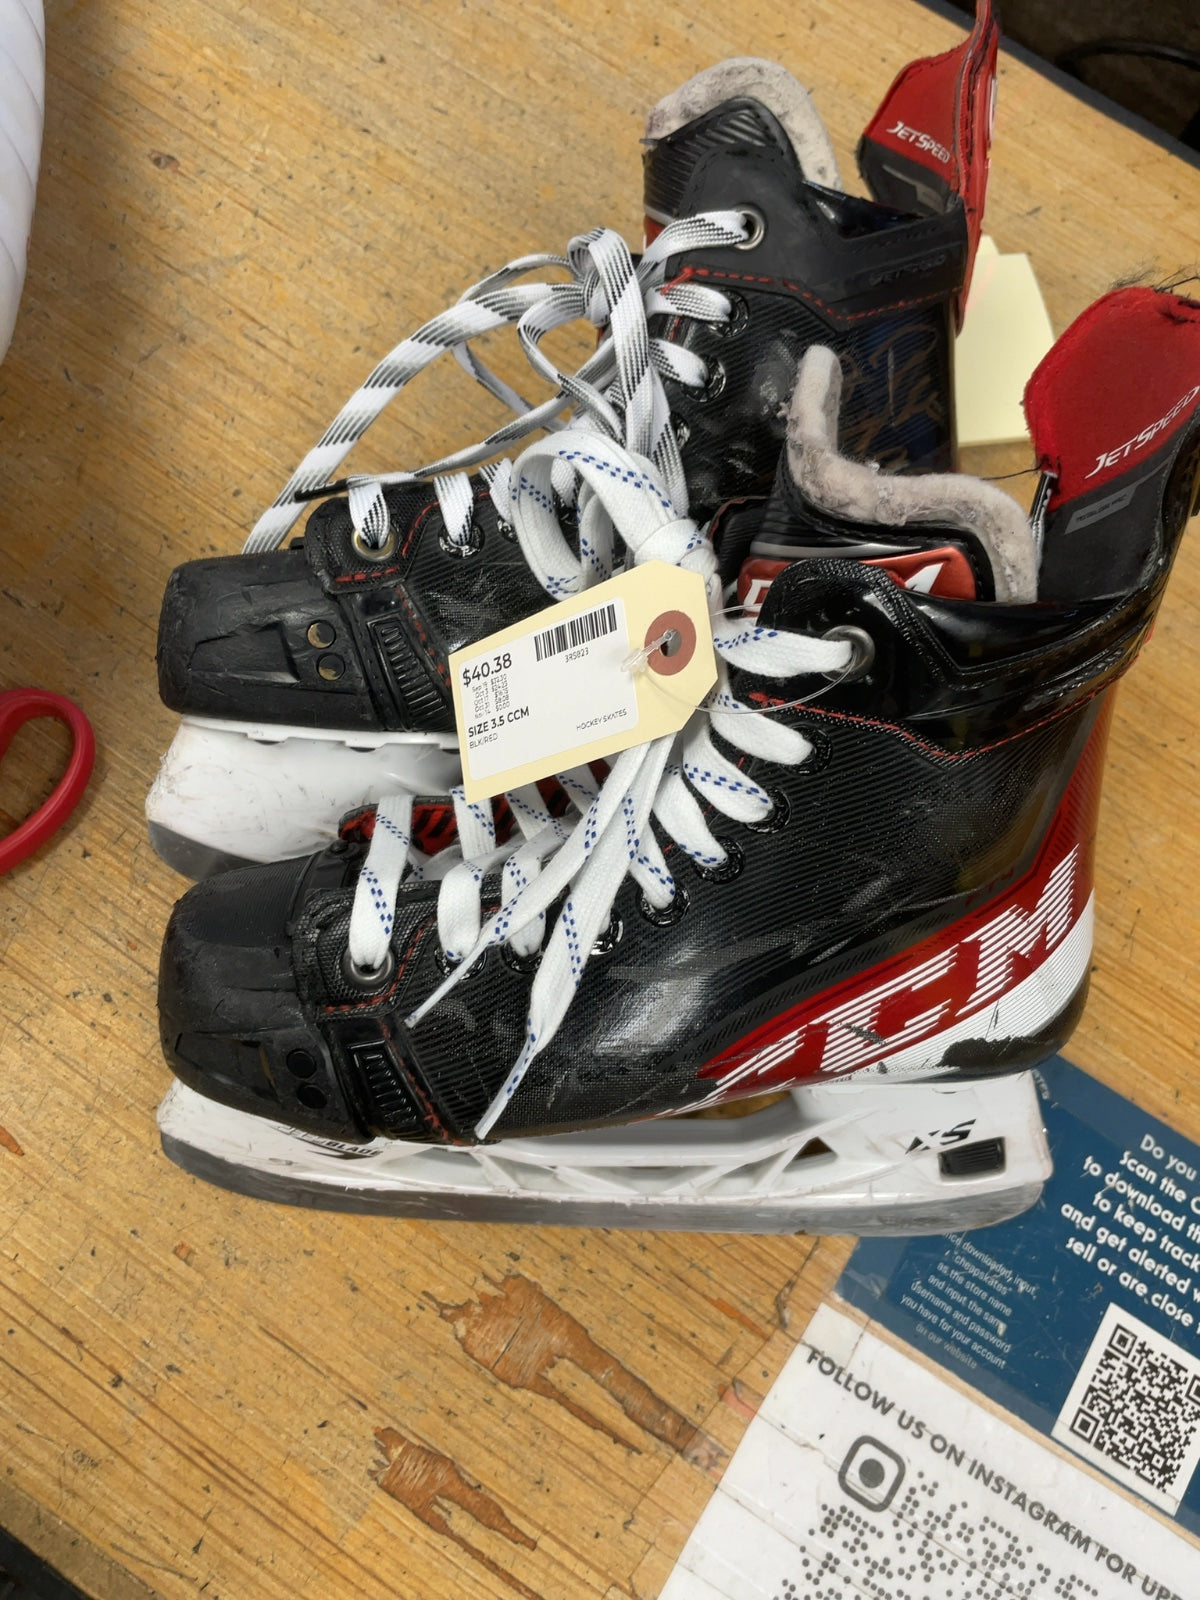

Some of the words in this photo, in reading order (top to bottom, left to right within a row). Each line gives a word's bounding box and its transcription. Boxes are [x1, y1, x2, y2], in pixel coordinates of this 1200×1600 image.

[885, 120, 950, 164] JETSPEED
[1084, 385, 1200, 479] JETSPEED
[463, 653, 512, 688] $40.38
[468, 721, 489, 738] SIZE
[491, 715, 505, 729] 3.5
[507, 706, 530, 723] CCM
[469, 733, 498, 749] BLK/RED
[576, 717, 602, 731] HOCKEY
[603, 708, 627, 723] SKATES
[1139, 1134, 1165, 1159] Do
[1165, 1155, 1198, 1182] you
[1082, 1155, 1102, 1177] to
[1104, 1172, 1187, 1232] download
[1159, 1176, 1187, 1203] the
[1060, 1203, 1096, 1232] and
[1096, 1227, 1128, 1252] get
[1128, 1248, 1192, 1294] alerted
[1092, 1192, 1111, 1213] to
[1113, 1204, 1157, 1243] keep
[1159, 1235, 1200, 1273] track
[928, 1274, 945, 1290] and
[945, 1284, 967, 1306] input
[967, 1300, 983, 1316] the
[937, 1262, 950, 1274] as
[949, 1268, 965, 1285] the
[964, 1280, 988, 1300] store
[988, 1296, 1013, 1317] name
[1065, 1237, 1098, 1263] sell
[1097, 1258, 1118, 1276] or
[1118, 1272, 1148, 1297] are
[1151, 1294, 1194, 1327] close
[900, 1294, 918, 1310] you
[917, 1303, 939, 1325] have
[939, 1318, 953, 1333] for
[952, 1328, 972, 1346] your
[971, 1341, 1007, 1370] account
[911, 1280, 953, 1315] username
[952, 1310, 970, 1326] and
[968, 1321, 1012, 1354] password
[928, 1331, 943, 1345] our
[944, 1341, 978, 1370] website
[806, 1347, 896, 1417] FOLLOW
[898, 1413, 926, 1441] US
[929, 1431, 968, 1468] ON
[967, 1457, 1092, 1554] INSTAGRAM
[1094, 1543, 1137, 1584] FOR
